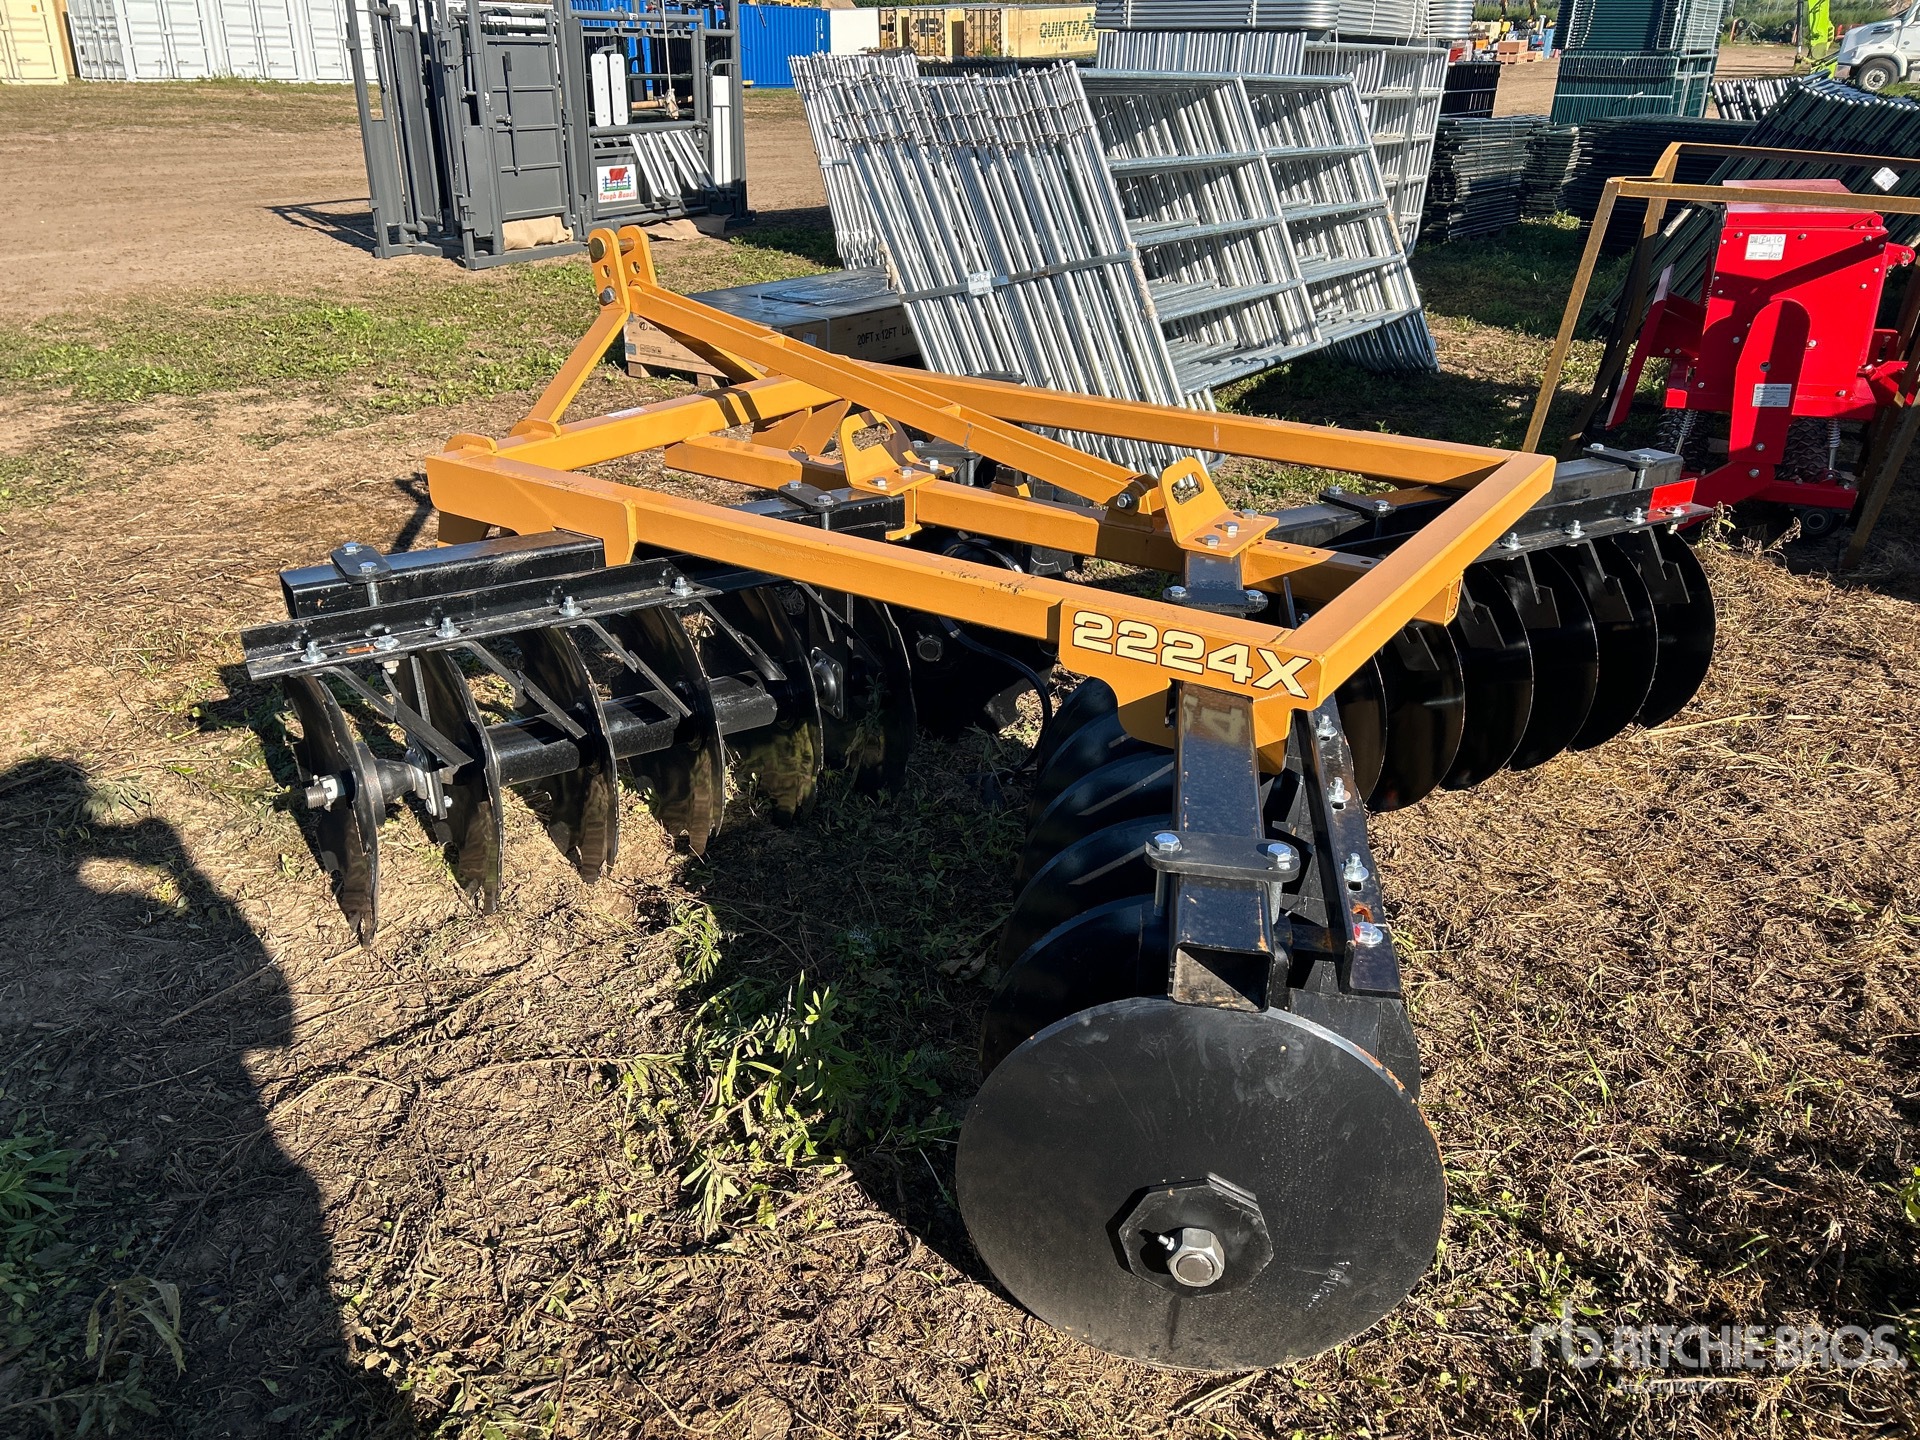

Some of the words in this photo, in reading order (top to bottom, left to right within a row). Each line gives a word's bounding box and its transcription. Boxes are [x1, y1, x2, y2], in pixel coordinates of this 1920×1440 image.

[599, 191, 616, 200] Tough
[618, 189, 636, 199] Ranch
[857, 332, 874, 346] 20FT
[882, 327, 897, 340] 12FT
[1072, 610, 1312, 699] 2224X
